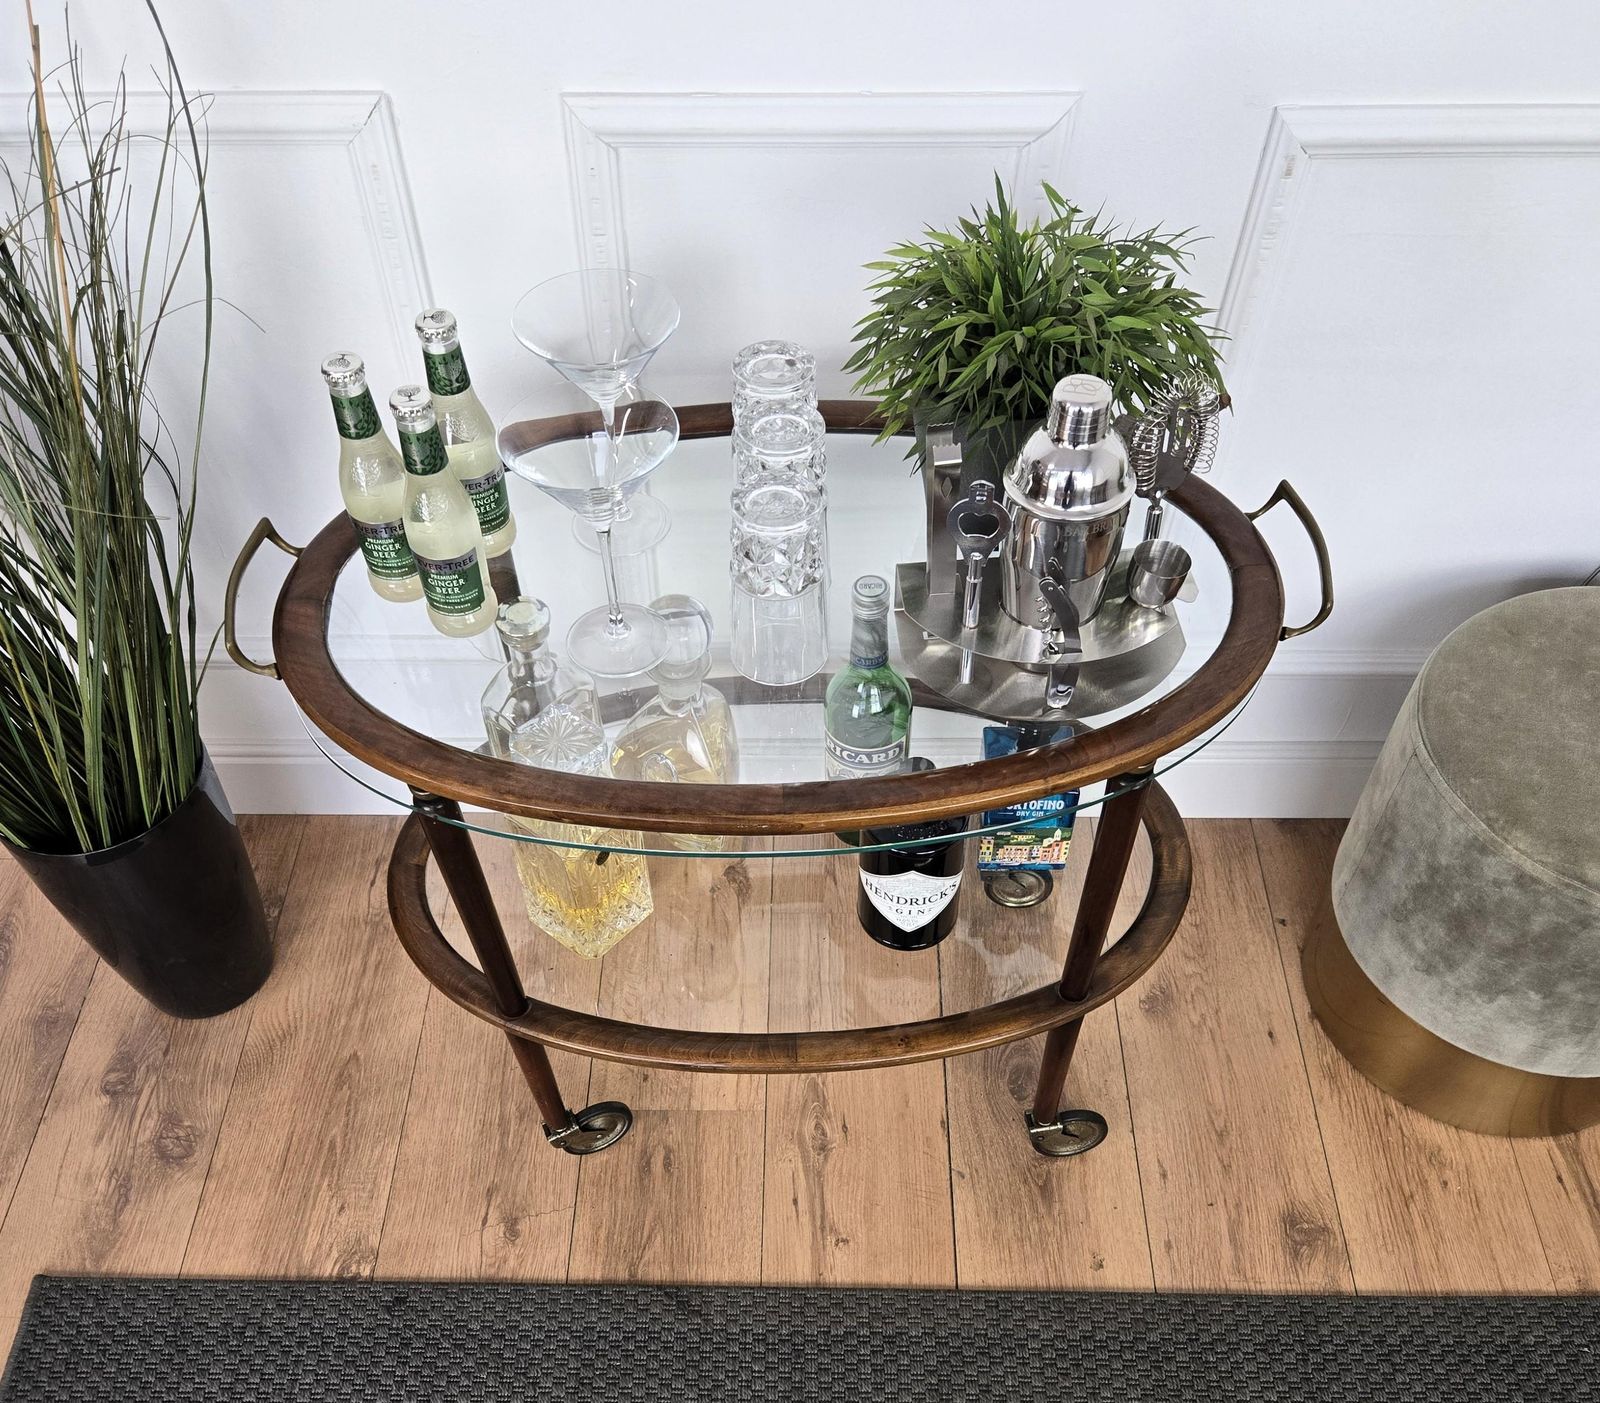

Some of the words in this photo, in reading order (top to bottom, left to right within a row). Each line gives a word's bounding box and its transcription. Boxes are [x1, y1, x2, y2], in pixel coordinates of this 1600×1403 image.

[472, 492, 499, 507] INGER
[365, 542, 401, 552] GINGER
[372, 550, 397, 559] BEER
[430, 573, 459, 581] PREMIUM
[428, 578, 465, 588] GINGER
[435, 586, 461, 594] BEER
[826, 735, 900, 764] RICARD
[865, 878, 958, 906] HENDRICK'S
